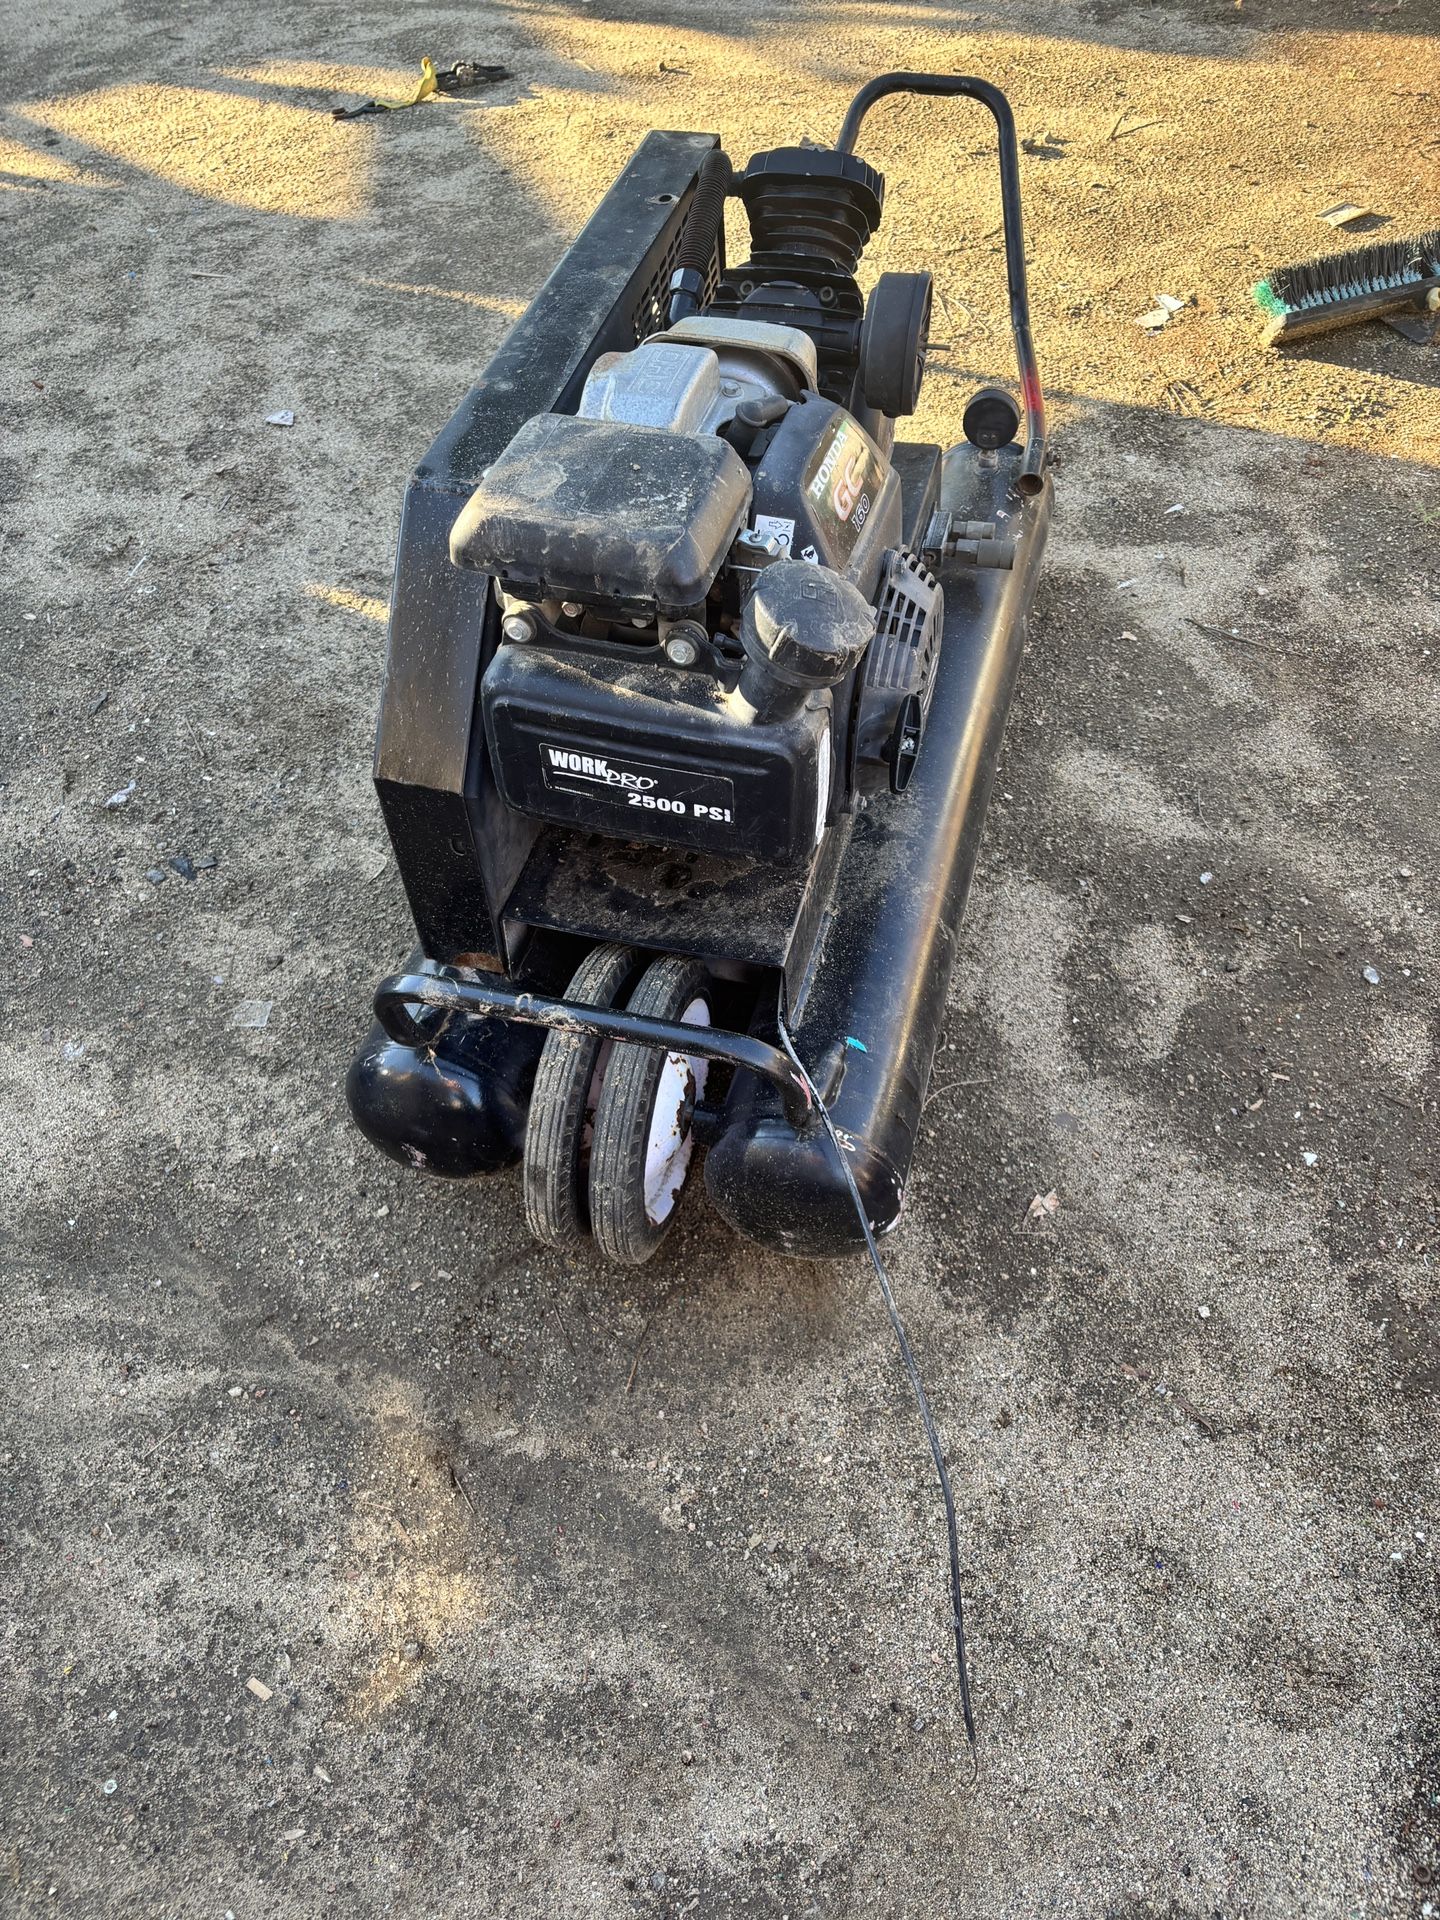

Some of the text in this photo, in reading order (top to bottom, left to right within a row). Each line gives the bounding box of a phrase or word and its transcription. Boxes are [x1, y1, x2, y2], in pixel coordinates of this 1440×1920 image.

[810, 431, 848, 500] HONDA
[833, 455, 864, 522] GC
[851, 493, 871, 533] 160
[627, 792, 732, 823] 2500 PSI
